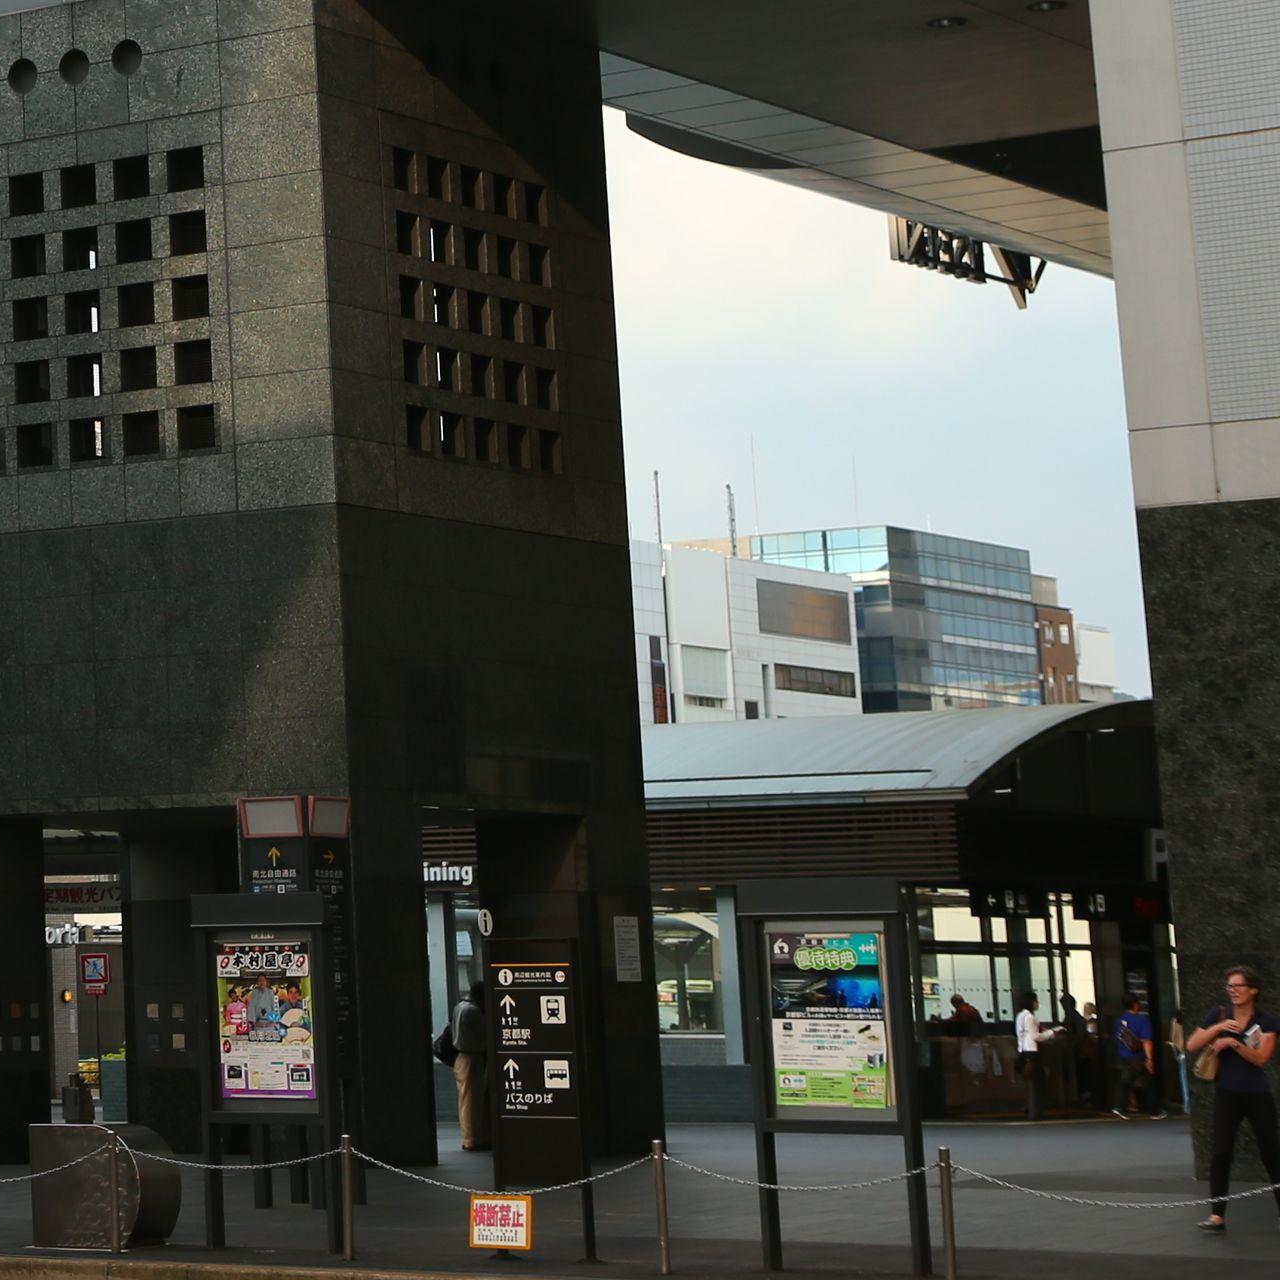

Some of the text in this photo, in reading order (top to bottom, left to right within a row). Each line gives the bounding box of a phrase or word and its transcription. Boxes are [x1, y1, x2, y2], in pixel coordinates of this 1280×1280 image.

[422, 861, 473, 886] ining
[795, 950, 855, 967] 優待特典
[502, 1028, 531, 1040] 京都駅
[506, 1093, 554, 1104] バスのりば
[474, 1203, 524, 1228] 横断禁止
